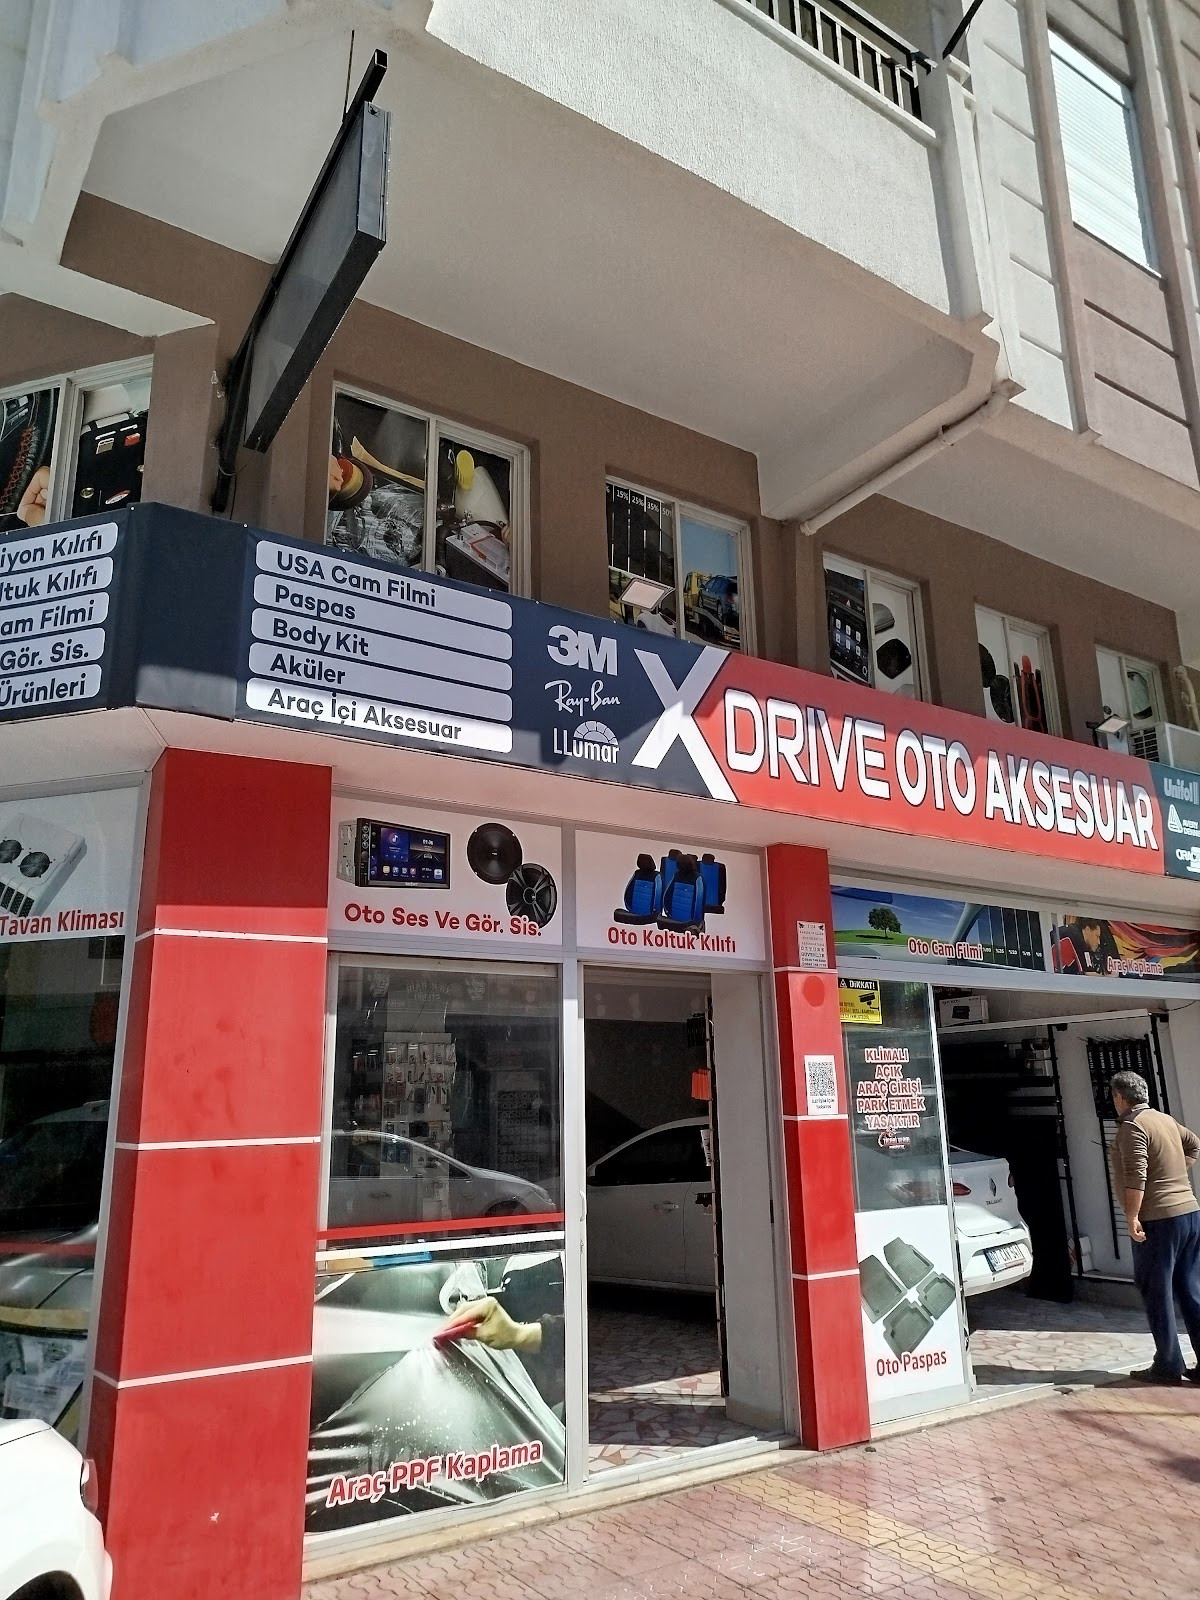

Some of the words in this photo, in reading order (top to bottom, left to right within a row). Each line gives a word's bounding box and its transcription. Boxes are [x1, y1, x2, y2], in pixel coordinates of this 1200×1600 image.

[616, 489, 629, 501] 15%
[631, 495, 645, 507] 25%
[647, 501, 660, 513] 35%
[51, 530, 102, 559] Kılıfı
[46, 566, 98, 593] Kılıfı
[277, 550, 325, 580] USA
[331, 564, 380, 593] Cam
[387, 579, 437, 607] Filmi
[40, 599, 95, 629] Filmi
[275, 584, 356, 620] Paspas
[272, 617, 332, 653] Body
[336, 631, 369, 657] Kit
[547, 625, 618, 676] 3M
[0, 646, 43, 671] Gör.
[49, 639, 89, 662] Sis.
[269, 653, 346, 685] Aküler
[0, 672, 86, 706] Ürünleri
[544, 679, 621, 717] Ray-Ban
[267, 688, 324, 721] Araç
[330, 692, 357, 725] İçi
[363, 704, 462, 740] Aksesuar
[553, 727, 620, 764] LLumar
[631, 645, 739, 802] X
[723, 687, 891, 801] DRIVE
[894, 728, 977, 816] OTO
[984, 750, 1160, 850] AKSESUAR
[0, 915, 51, 936] Tavan
[57, 909, 124, 932] Kliması
[344, 903, 385, 924] Oto
[392, 907, 429, 928] Ses
[434, 910, 460, 930] Ve
[465, 913, 504, 934] Gör.
[509, 916, 542, 937] Sis.
[607, 926, 638, 946] Oto
[642, 929, 696, 950] Koltuk
[701, 934, 736, 953] Kılıfı
[907, 937, 929, 955] Oto
[931, 940, 956, 959] Cam
[956, 941, 984, 961] Filmi
[1107, 956, 1127, 976] Araç
[1127, 958, 1164, 977] Kaplama
[865, 1046, 909, 1063] KLİMALI
[875, 1064, 903, 1081] AÇIK
[857, 1081, 888, 1098] ARAÇ
[889, 1078, 922, 1097] GİRİŞİ
[857, 1098, 888, 1112] PARK
[888, 1097, 926, 1111] ETMEK
[865, 1114, 920, 1129] YASAKTIR
[876, 1358, 899, 1377] Oto
[902, 1351, 947, 1372] Paspas
[326, 1471, 385, 1507] Araç
[391, 1457, 440, 1491] PPF
[446, 1441, 543, 1482] Kaplama
